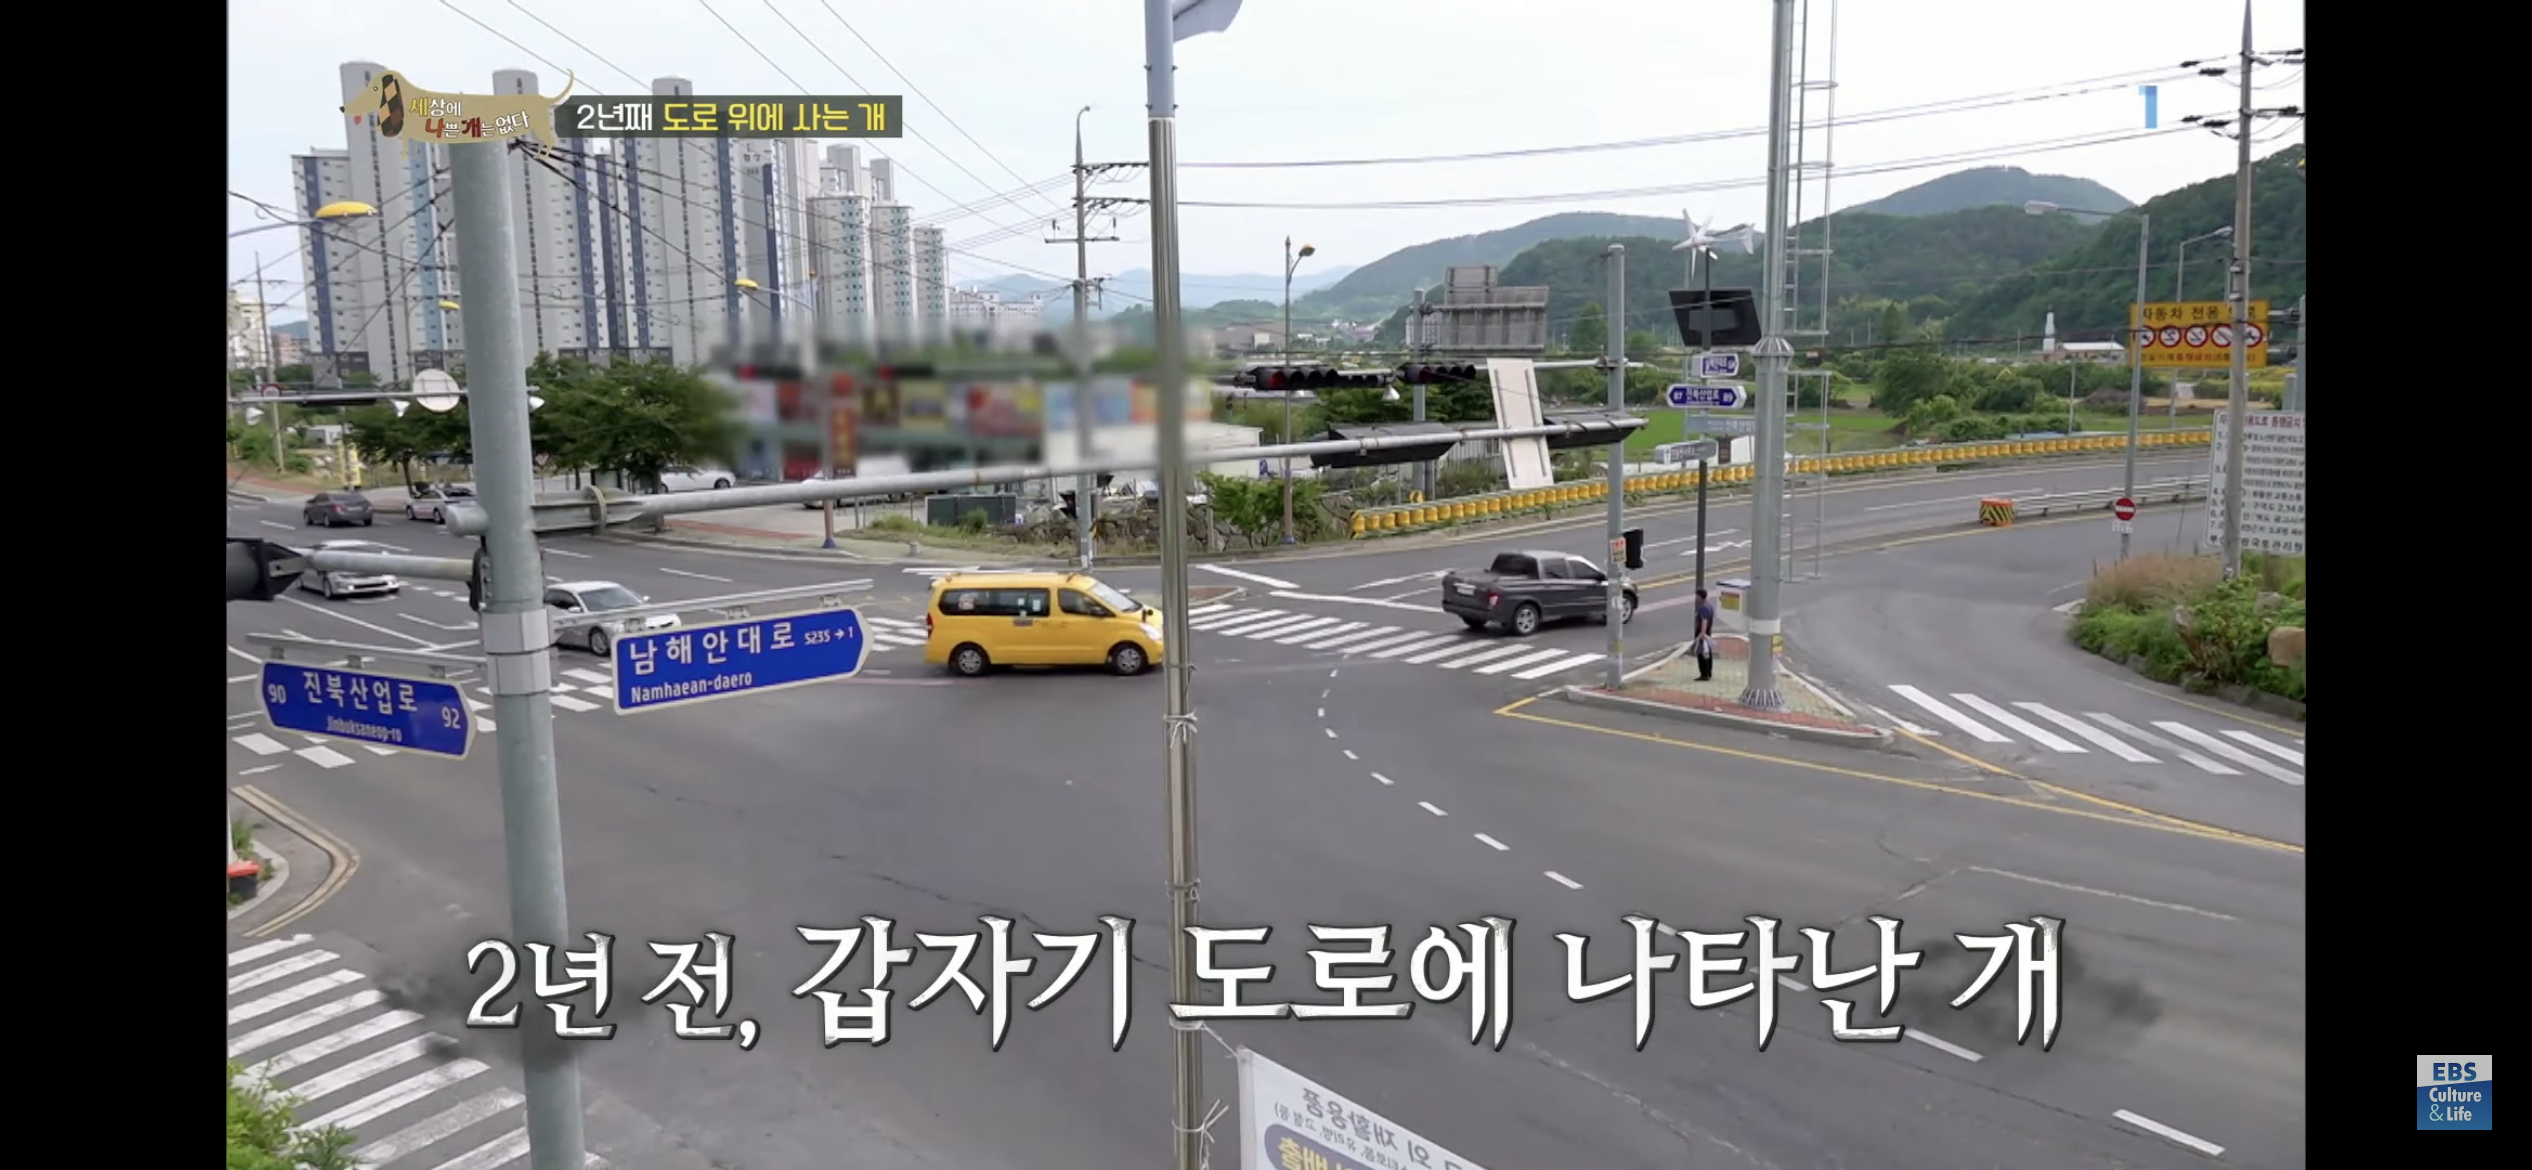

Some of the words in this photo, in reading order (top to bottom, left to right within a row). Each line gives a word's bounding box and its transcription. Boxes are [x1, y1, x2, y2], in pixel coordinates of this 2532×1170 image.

[2143, 306, 2184, 321] 자동차
[630, 621, 796, 677] 남해안대로
[267, 683, 287, 705] 90
[302, 671, 418, 716] 진북산업로
[441, 706, 462, 730] 92
[630, 671, 753, 704] Namhaean-daero
